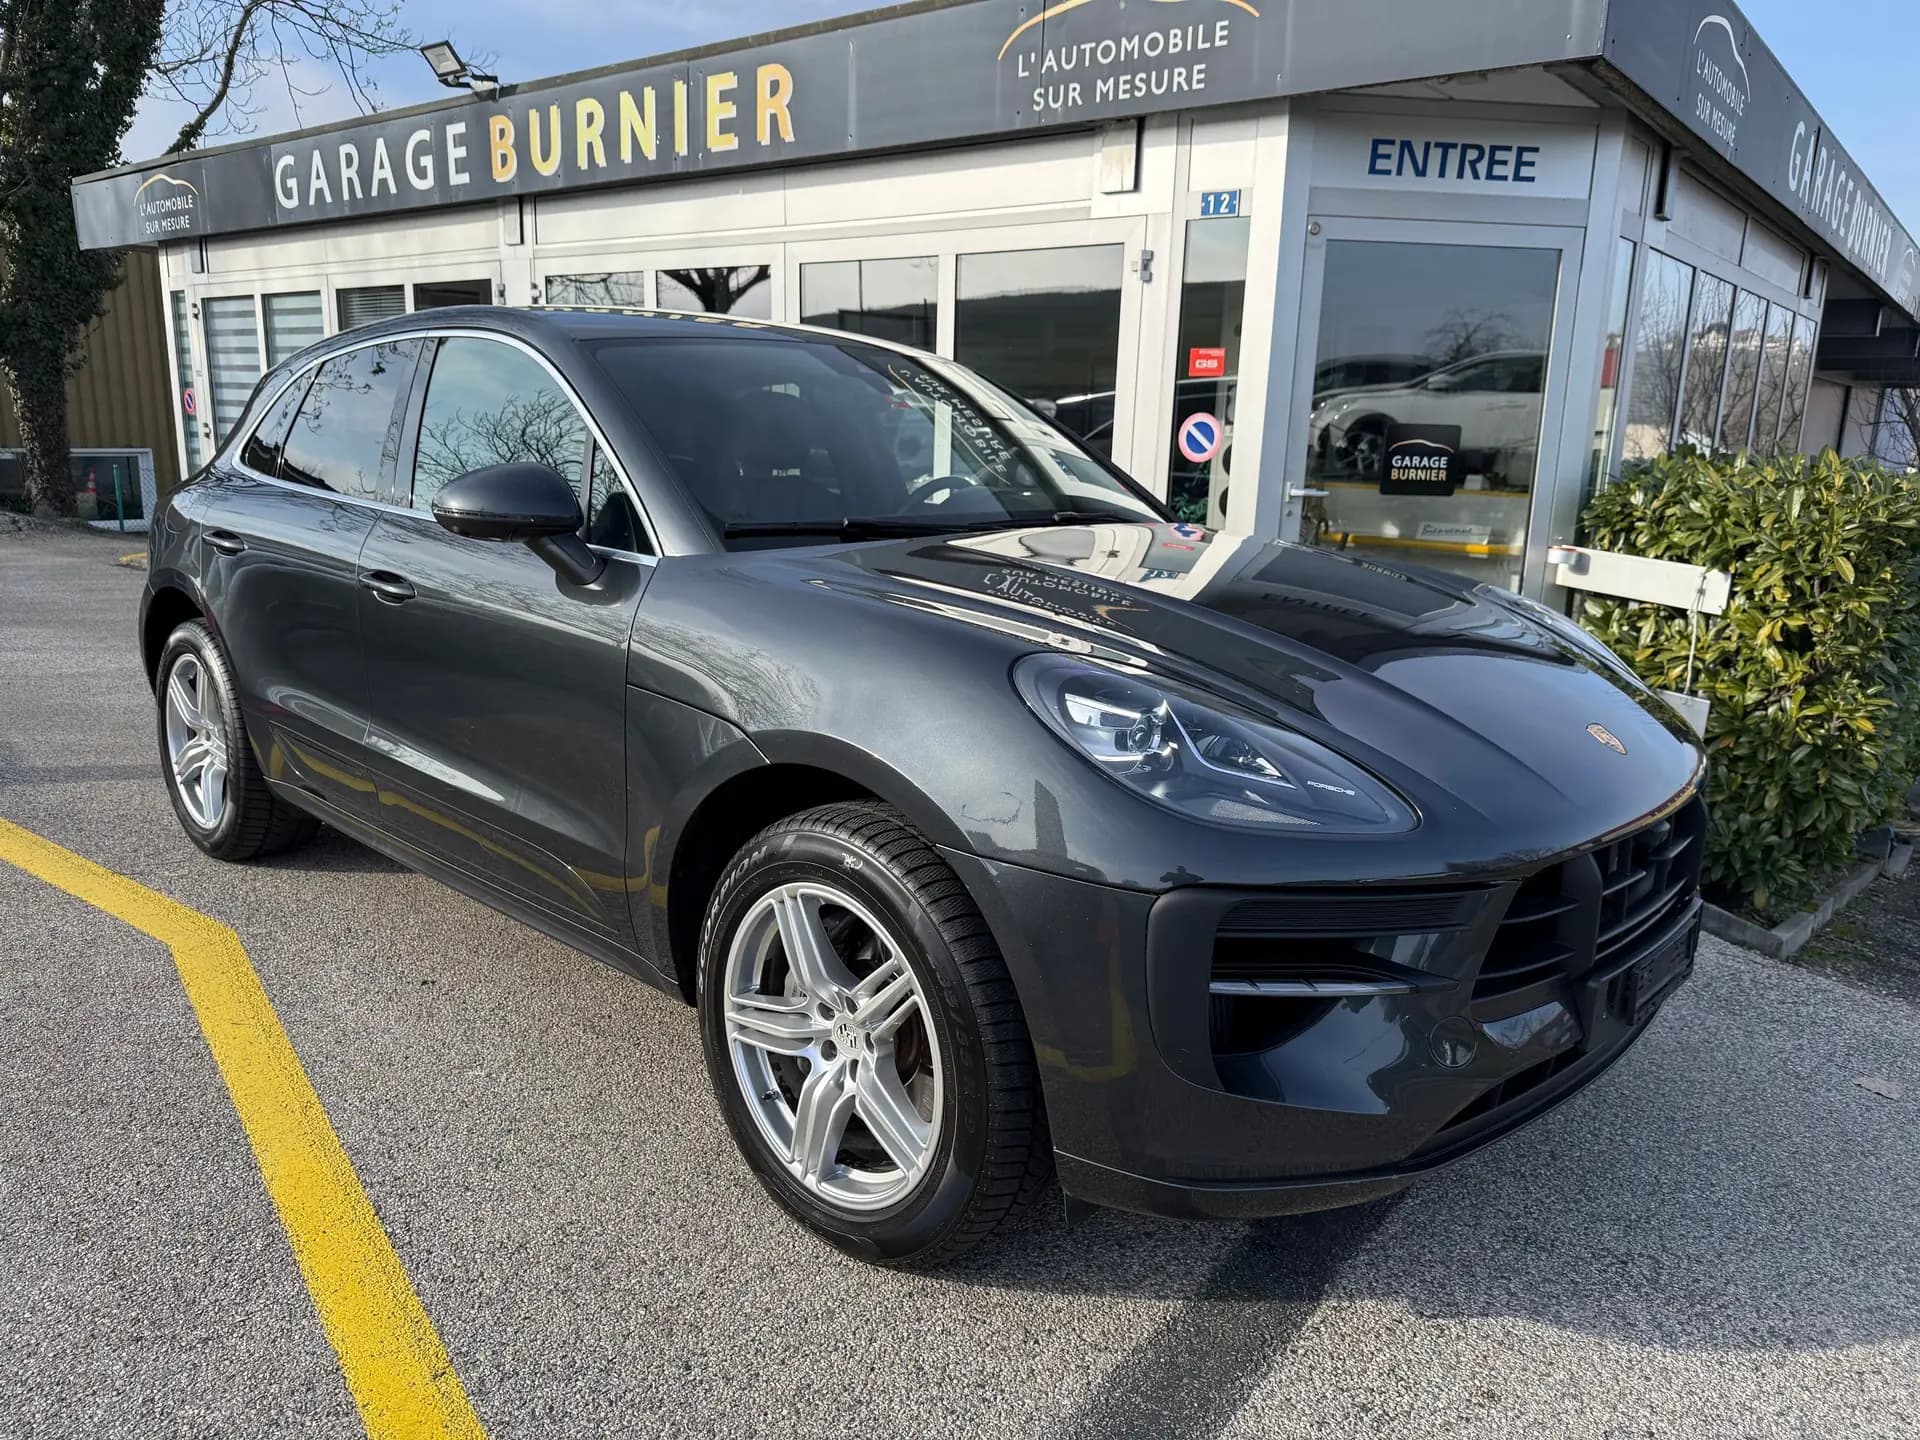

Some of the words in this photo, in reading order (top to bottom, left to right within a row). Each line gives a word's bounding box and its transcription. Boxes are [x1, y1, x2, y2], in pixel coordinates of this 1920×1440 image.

[1017, 20, 1230, 78] L'AUTOMOBILE
[1032, 83, 1083, 112] SUR
[1095, 64, 1207, 104] MESURE
[1697, 48, 1745, 116] L'AUTOMOBILE
[275, 122, 471, 209] GARAGE
[489, 63, 795, 183] BURNIER
[1696, 92, 1711, 126] SUR
[1711, 106, 1736, 147] MESURE
[1367, 138, 1541, 183] ENTREE
[140, 194, 194, 216] L'AUTOMOBILE
[145, 219, 160, 234] SUR
[161, 214, 190, 232] MESURE
[1207, 193, 1230, 214] 12
[1788, 120, 1854, 237] GARAGE
[1847, 190, 1893, 282] BURNIER
[1390, 468, 1447, 481] BURNIER
[1391, 455, 1448, 468] GARAGE
